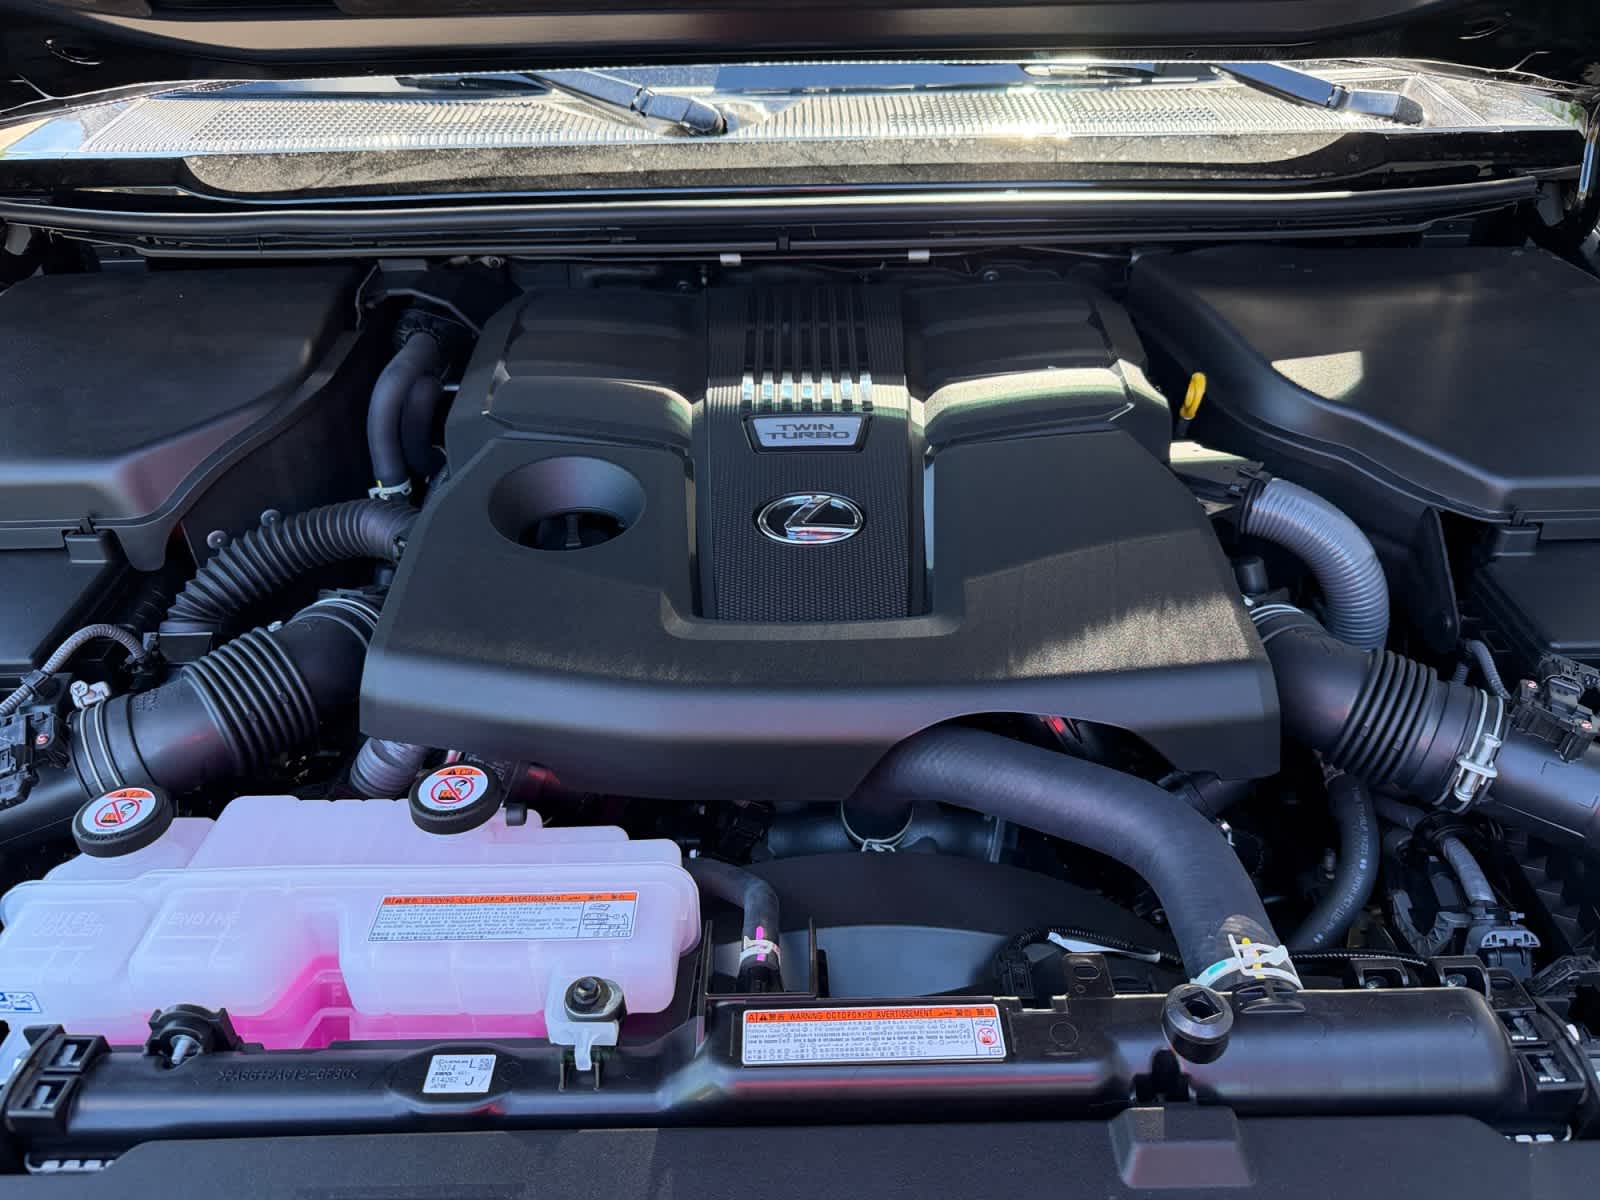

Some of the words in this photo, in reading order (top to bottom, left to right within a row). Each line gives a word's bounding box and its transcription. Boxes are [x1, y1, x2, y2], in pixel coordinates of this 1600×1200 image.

[775, 423, 835, 431] TWIN
[765, 431, 850, 440] TURBO
[790, 1011, 824, 1020] WARNING
[877, 1008, 933, 1018] AVERTISSEMENT
